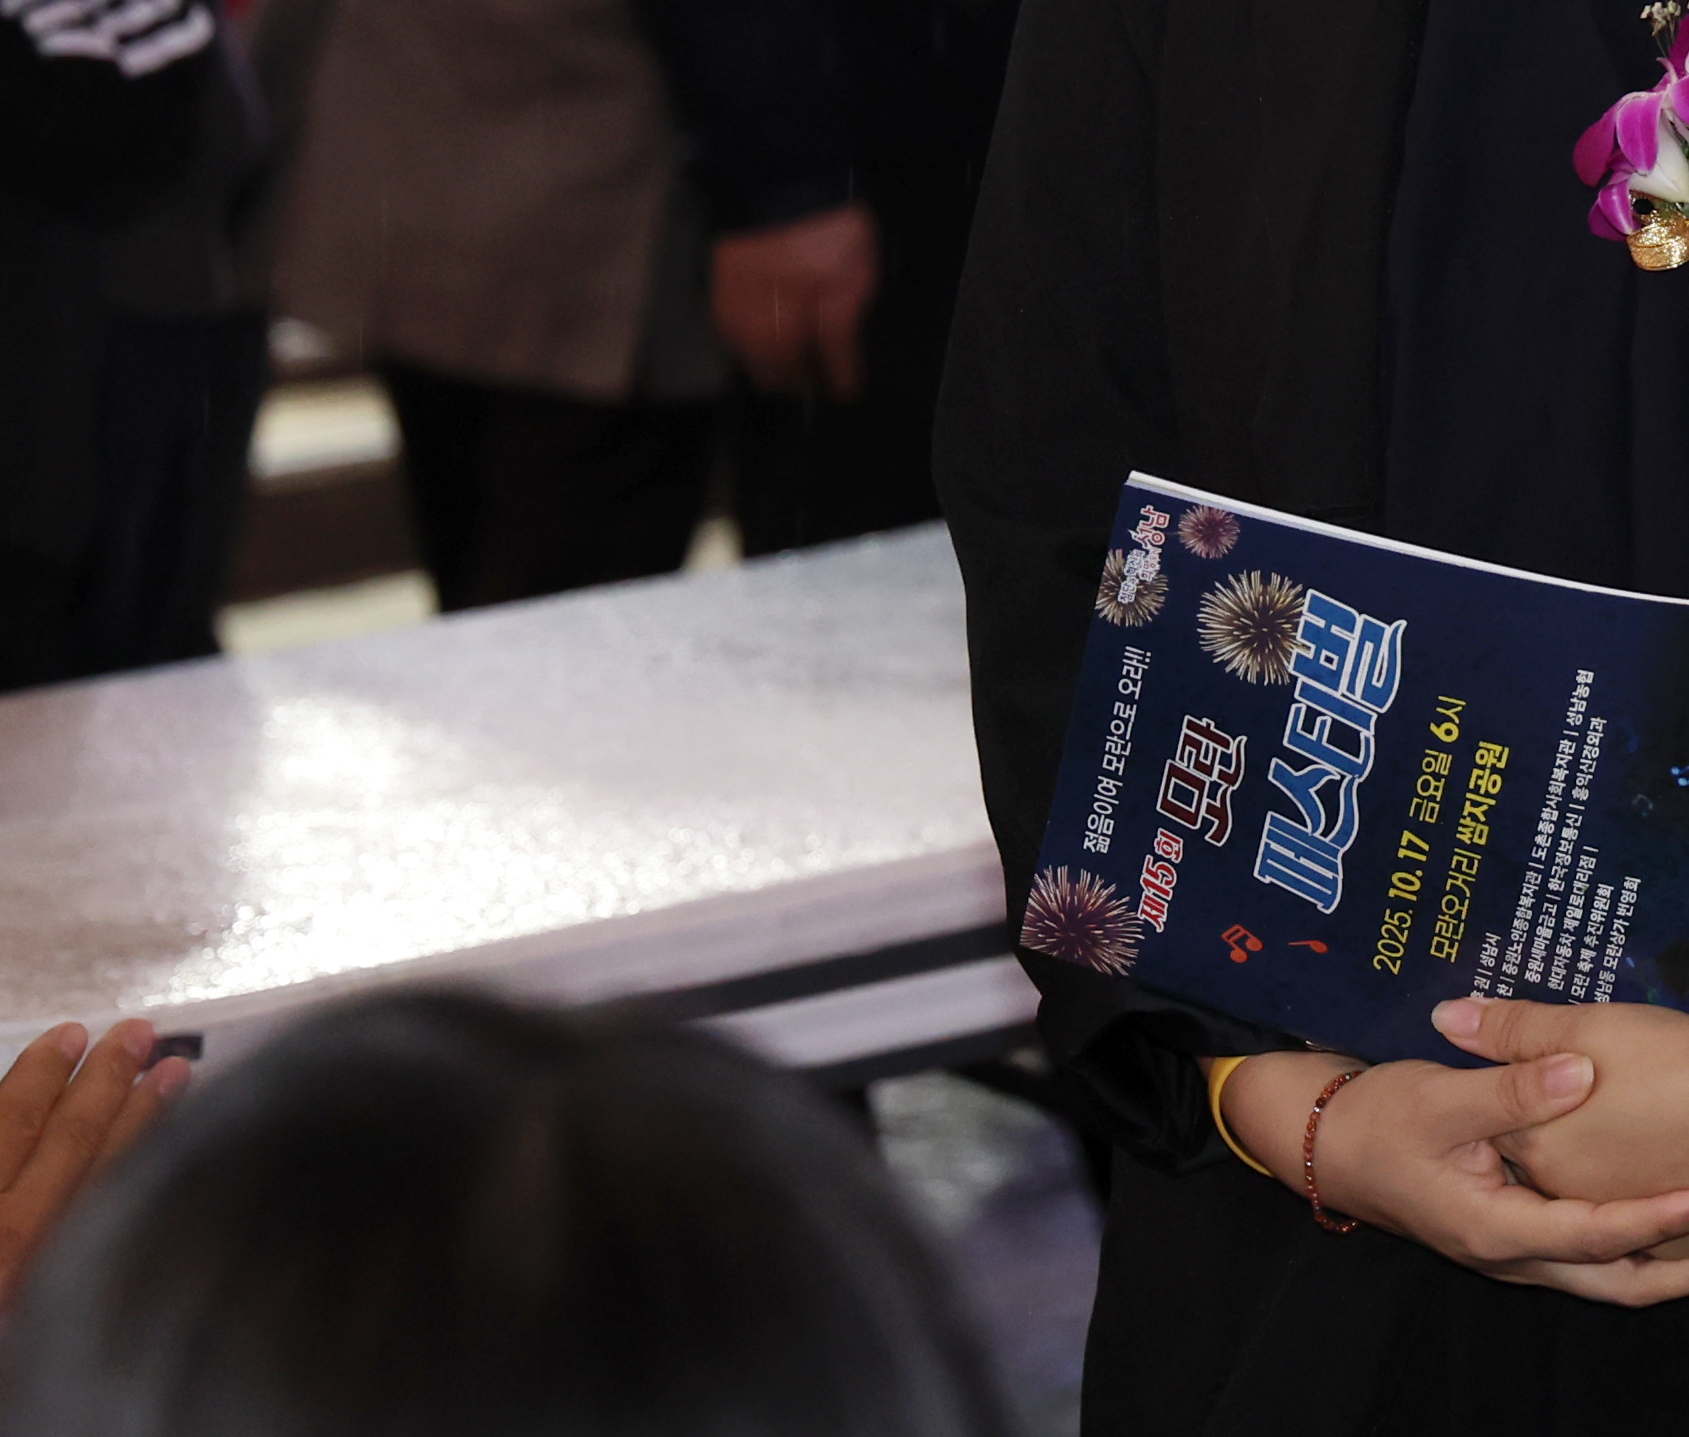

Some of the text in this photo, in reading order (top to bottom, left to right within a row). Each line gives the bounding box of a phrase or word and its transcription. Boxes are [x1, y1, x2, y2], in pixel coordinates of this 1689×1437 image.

[1128, 504, 1170, 551] 성남
[1083, 646, 1151, 853] 젊음이여 모란으로 오라!!
[1253, 589, 1407, 914] 페스티벌
[1410, 750, 1452, 822] 금요일
[1430, 696, 1466, 742] 6시
[1133, 715, 1247, 932] 제15회 모란
[1431, 742, 1509, 962] 모란오거리 쌈지공원
[1502, 872, 1541, 974] 중원노인종합복지관
[1532, 739, 1576, 860] 도촌종합사회복지관
[1567, 670, 1594, 726] 성남농협
[1525, 717, 1607, 982] 중원새마을금고 한국정보통신 홍익신경외과
[1480, 933, 1500, 967] 성남시
[1548, 855, 1596, 990] 현대자동차 제일로대리점
[1571, 884, 1614, 998] 모란 축제 추진위원회
[1594, 877, 1641, 1004] 성남동 모란상가 번영회
